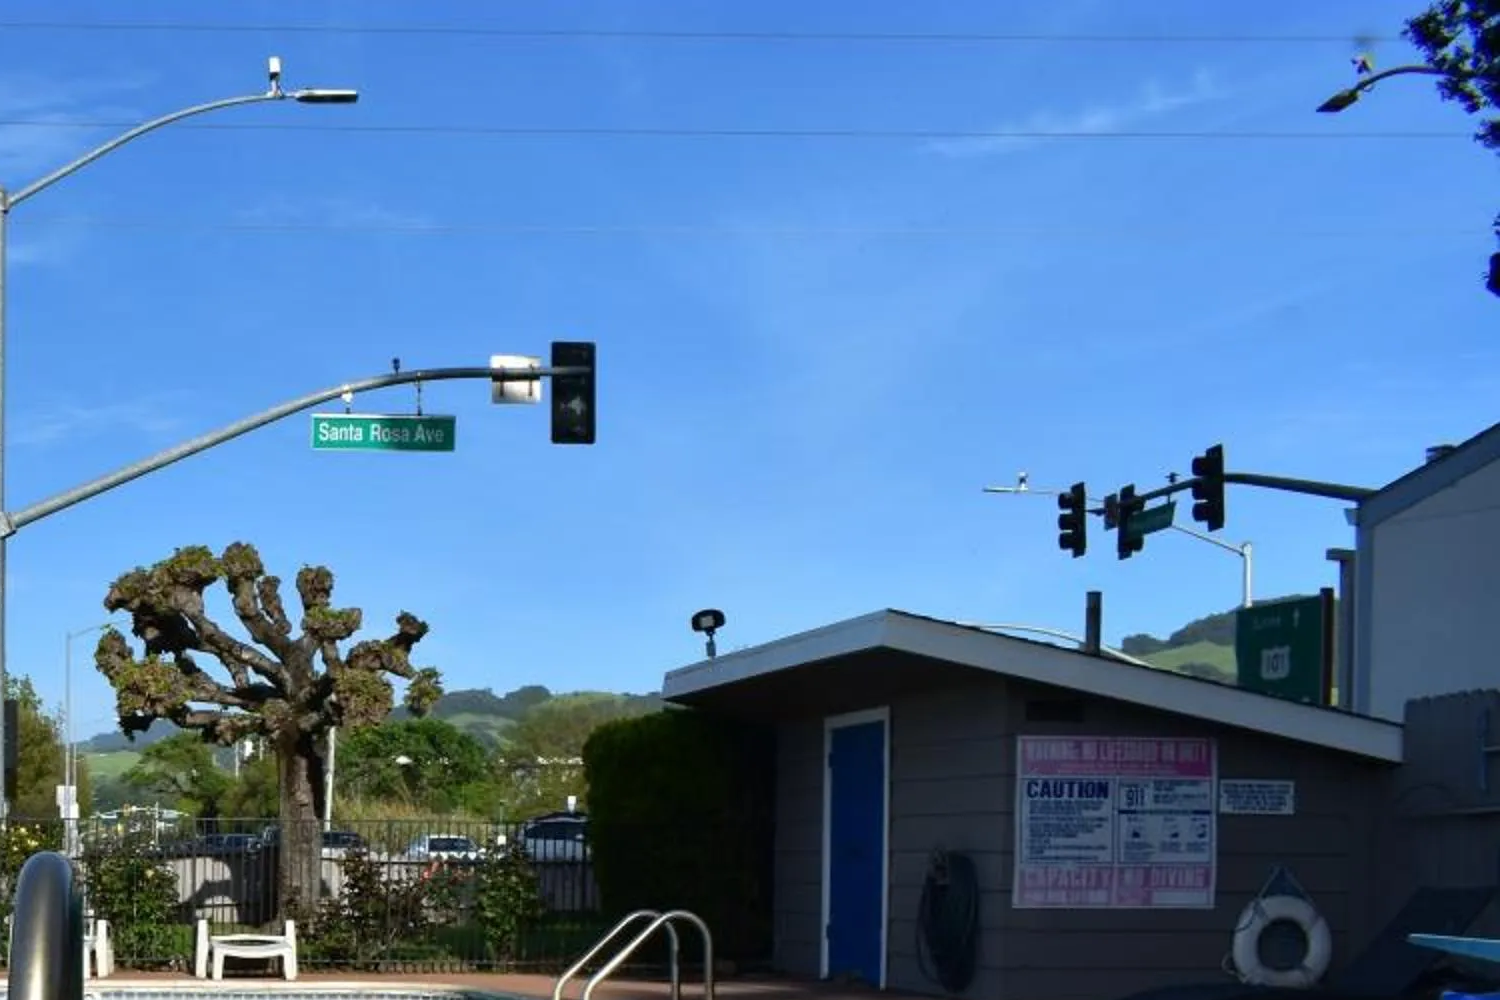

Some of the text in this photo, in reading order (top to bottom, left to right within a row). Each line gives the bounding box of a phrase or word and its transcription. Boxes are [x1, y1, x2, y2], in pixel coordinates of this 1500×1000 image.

[318, 421, 445, 443] Santa Rosa Ave
[1266, 651, 1285, 673] 101
[1026, 780, 1109, 798] CAUTION
[1126, 788, 1145, 807] 911
